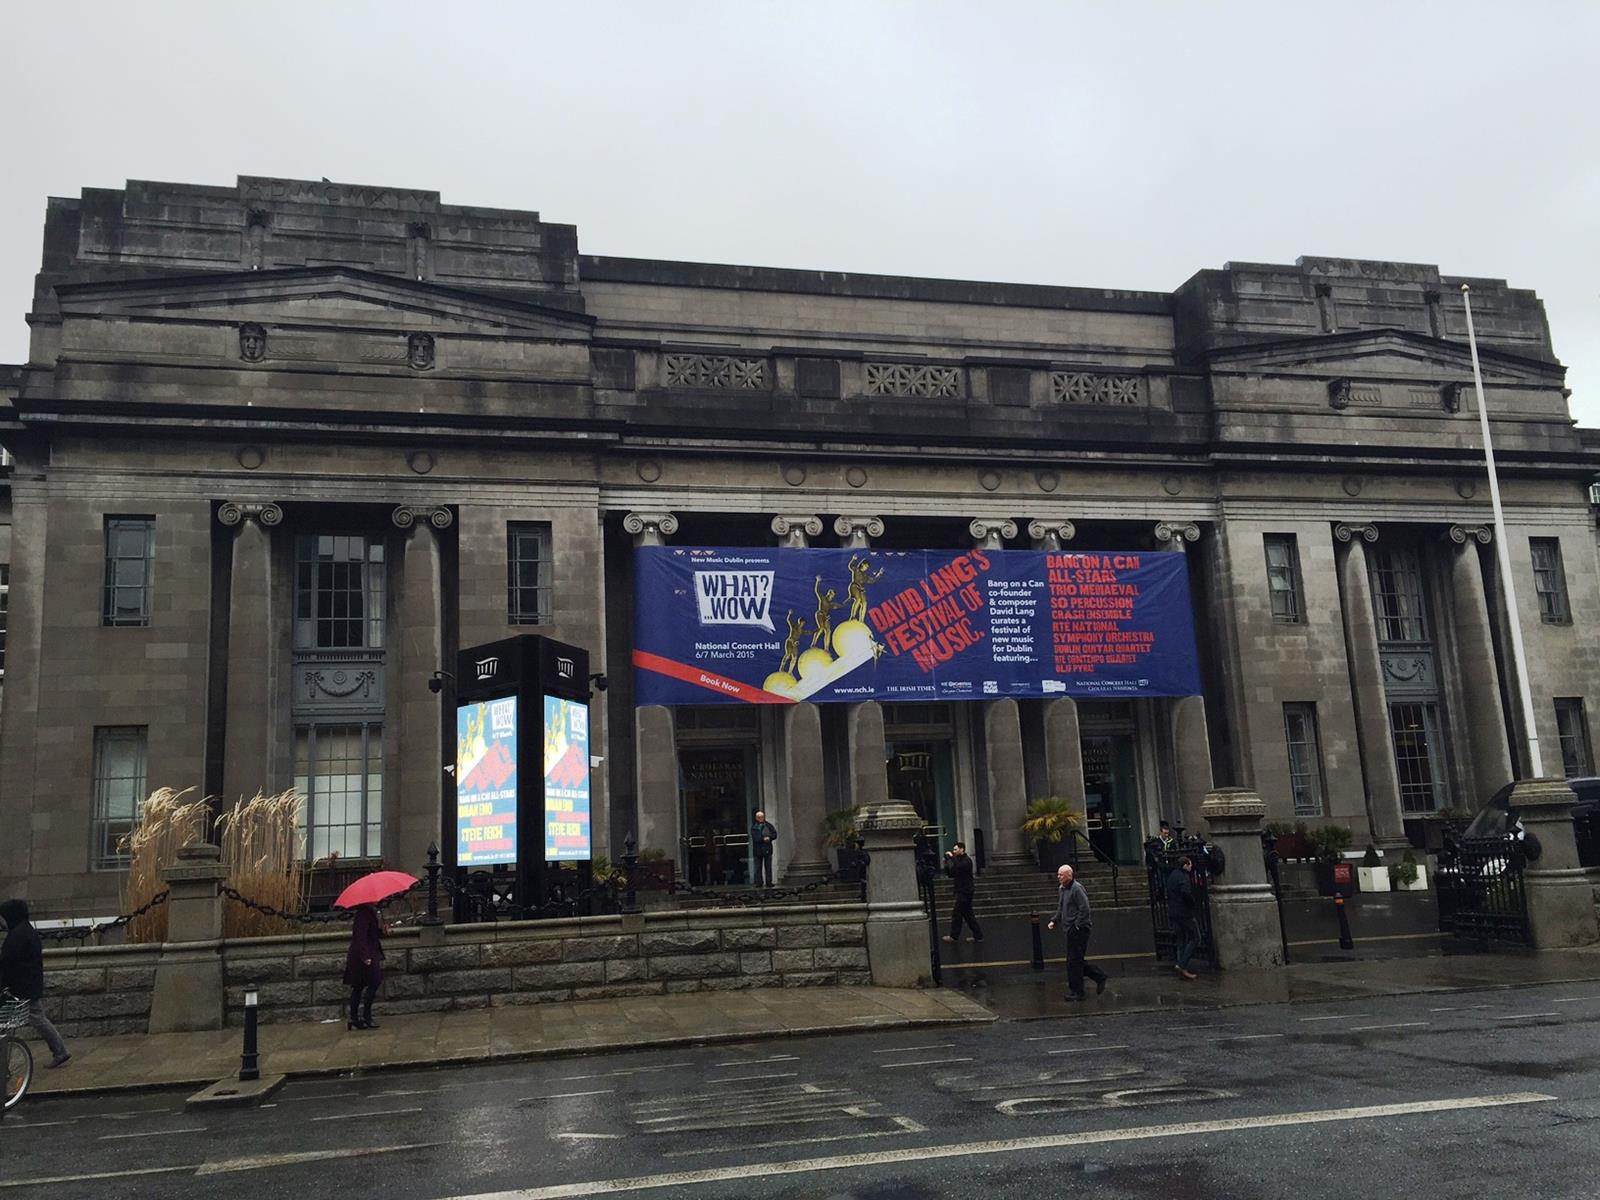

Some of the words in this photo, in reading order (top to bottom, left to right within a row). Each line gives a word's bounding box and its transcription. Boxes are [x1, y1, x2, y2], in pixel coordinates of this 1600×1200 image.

[1082, 555, 1100, 569] ON
[1103, 555, 1111, 569] A
[1114, 555, 1140, 569] CAN
[1048, 570, 1117, 583] ALL-STARS
[702, 575, 769, 597] WHAT?
[987, 579, 1009, 589] Bang
[868, 587, 925, 633] DAVID
[920, 548, 991, 603] LANG'S
[988, 589, 1032, 597] co-founder
[1049, 584, 1077, 595] TRIO
[1080, 584, 1140, 596] MEDIAEVAL
[704, 597, 767, 620] ...WOW
[989, 598, 996, 606] &
[998, 600, 1037, 608] composer
[1050, 597, 1068, 609] SO
[1071, 597, 1133, 608] PERCUSSION
[990, 607, 1013, 615] David
[1015, 607, 1035, 617] Lang
[1051, 610, 1085, 619] CRASH
[885, 595, 966, 657] FESTIVAL
[960, 582, 984, 611] OF
[991, 626, 1020, 634] festival
[1022, 625, 1031, 633] of
[1072, 621, 1119, 632] NATIONAL
[1011, 635, 1034, 643] music
[1053, 633, 1103, 643] SYMPHONY
[1106, 632, 1154, 642] ORCHESTRA
[695, 642, 729, 650] National
[731, 642, 763, 650] Concert
[764, 642, 780, 650] Hall
[912, 618, 985, 673] MUSIC.
[992, 644, 1005, 652] for
[1006, 644, 1033, 652] Dublin
[695, 651, 708, 659] 6/7
[710, 651, 734, 659] March
[736, 651, 755, 659] 2015
[993, 654, 1039, 663] featuring...
[700, 674, 721, 688] Book
[721, 681, 740, 693] Now
